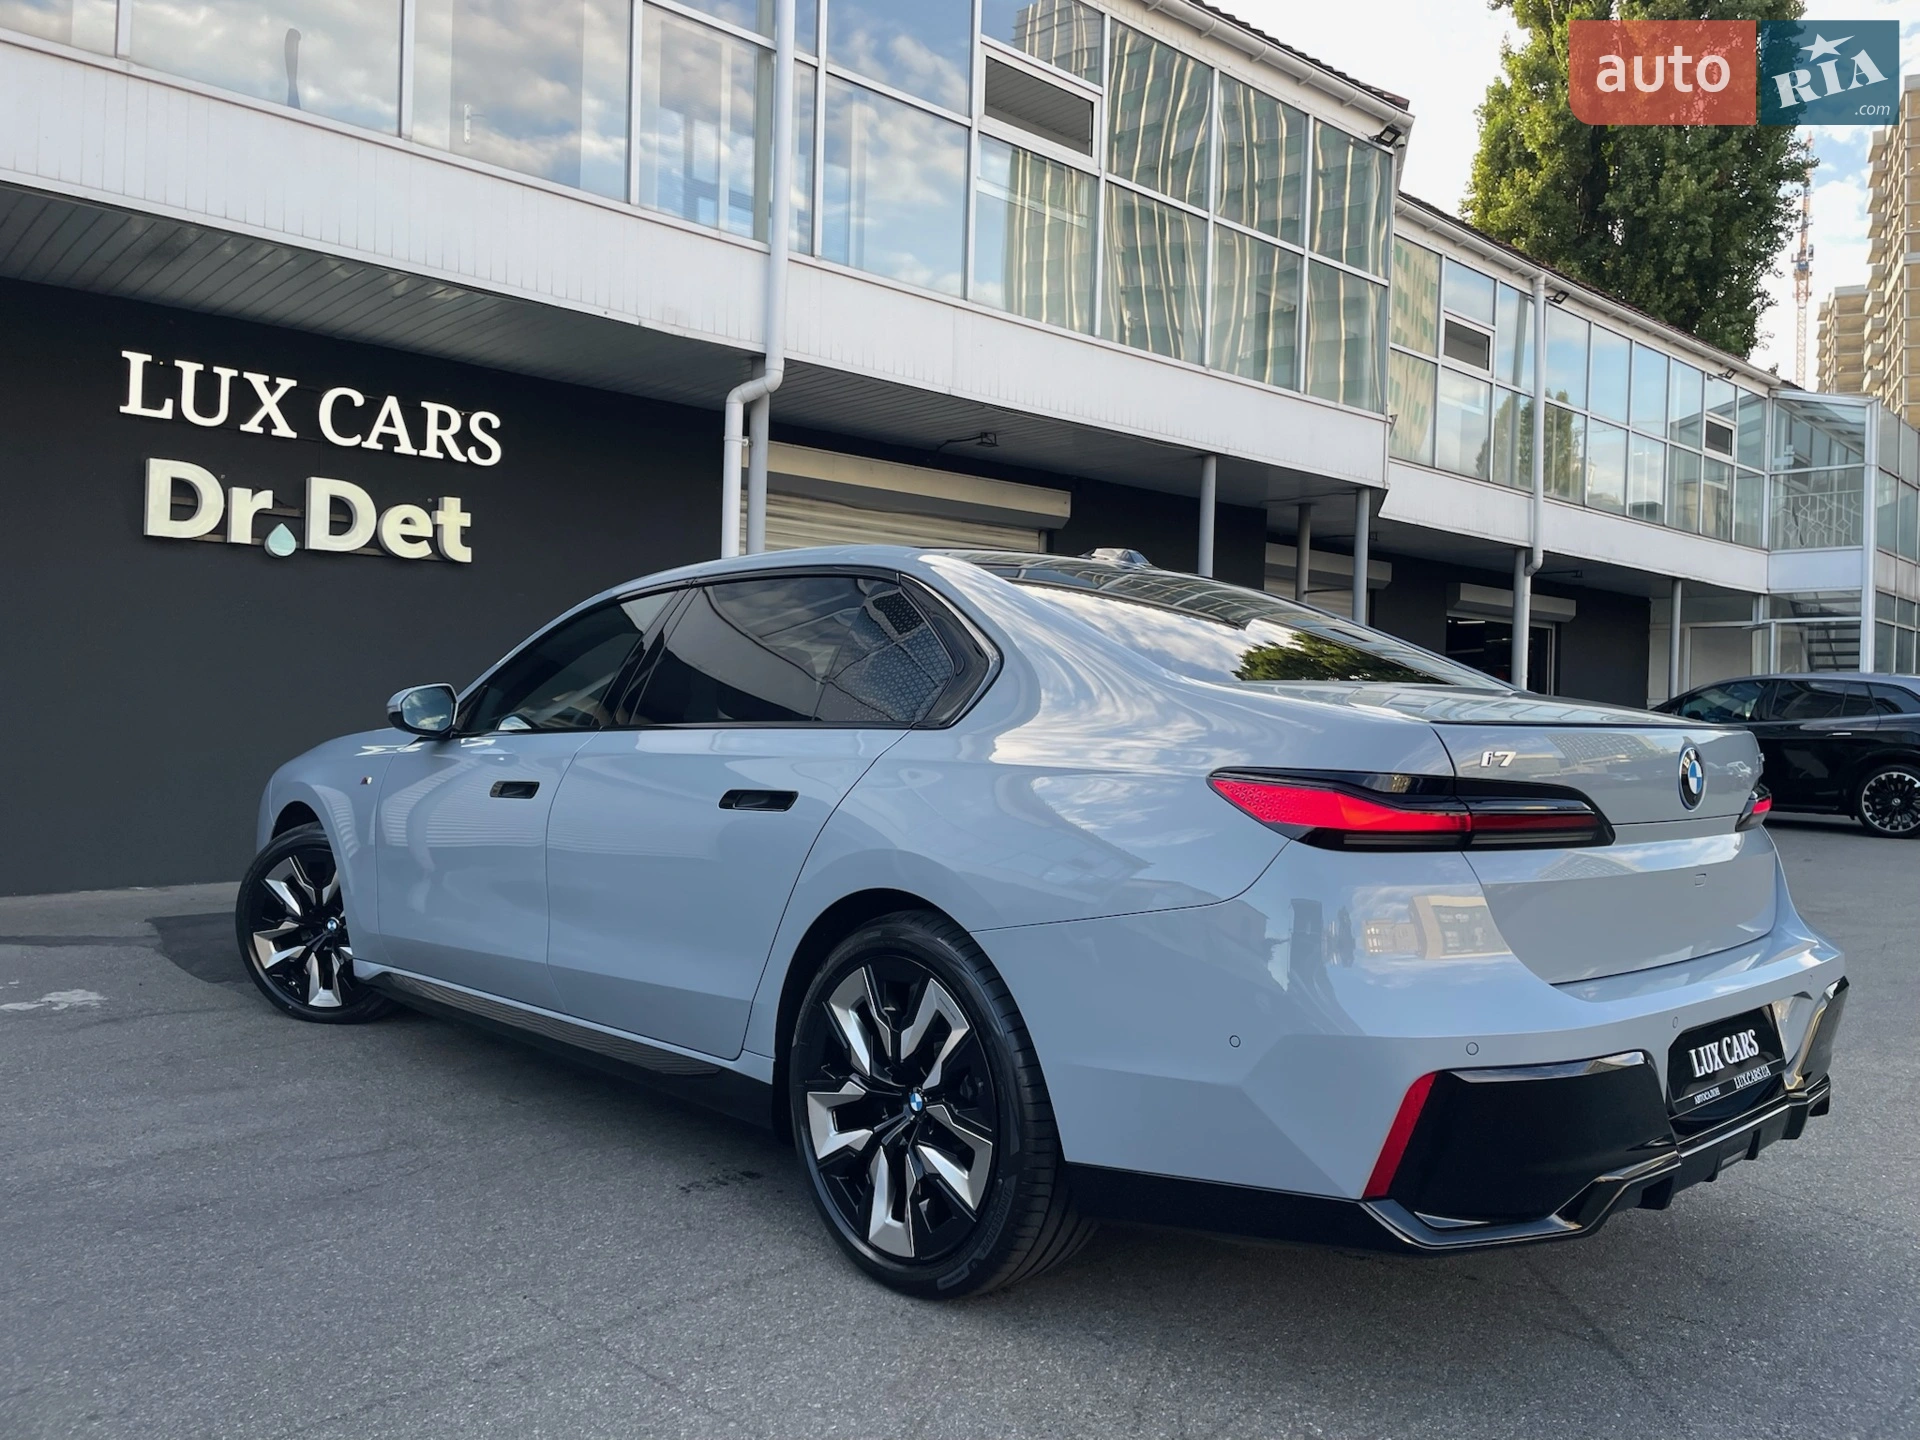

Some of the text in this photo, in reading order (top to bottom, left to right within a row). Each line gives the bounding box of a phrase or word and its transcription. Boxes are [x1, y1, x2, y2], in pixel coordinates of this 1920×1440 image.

[119, 351, 502, 467] LUX CARS
[1480, 751, 1517, 767] i7
[1688, 1029, 1759, 1078] LUX CARS
